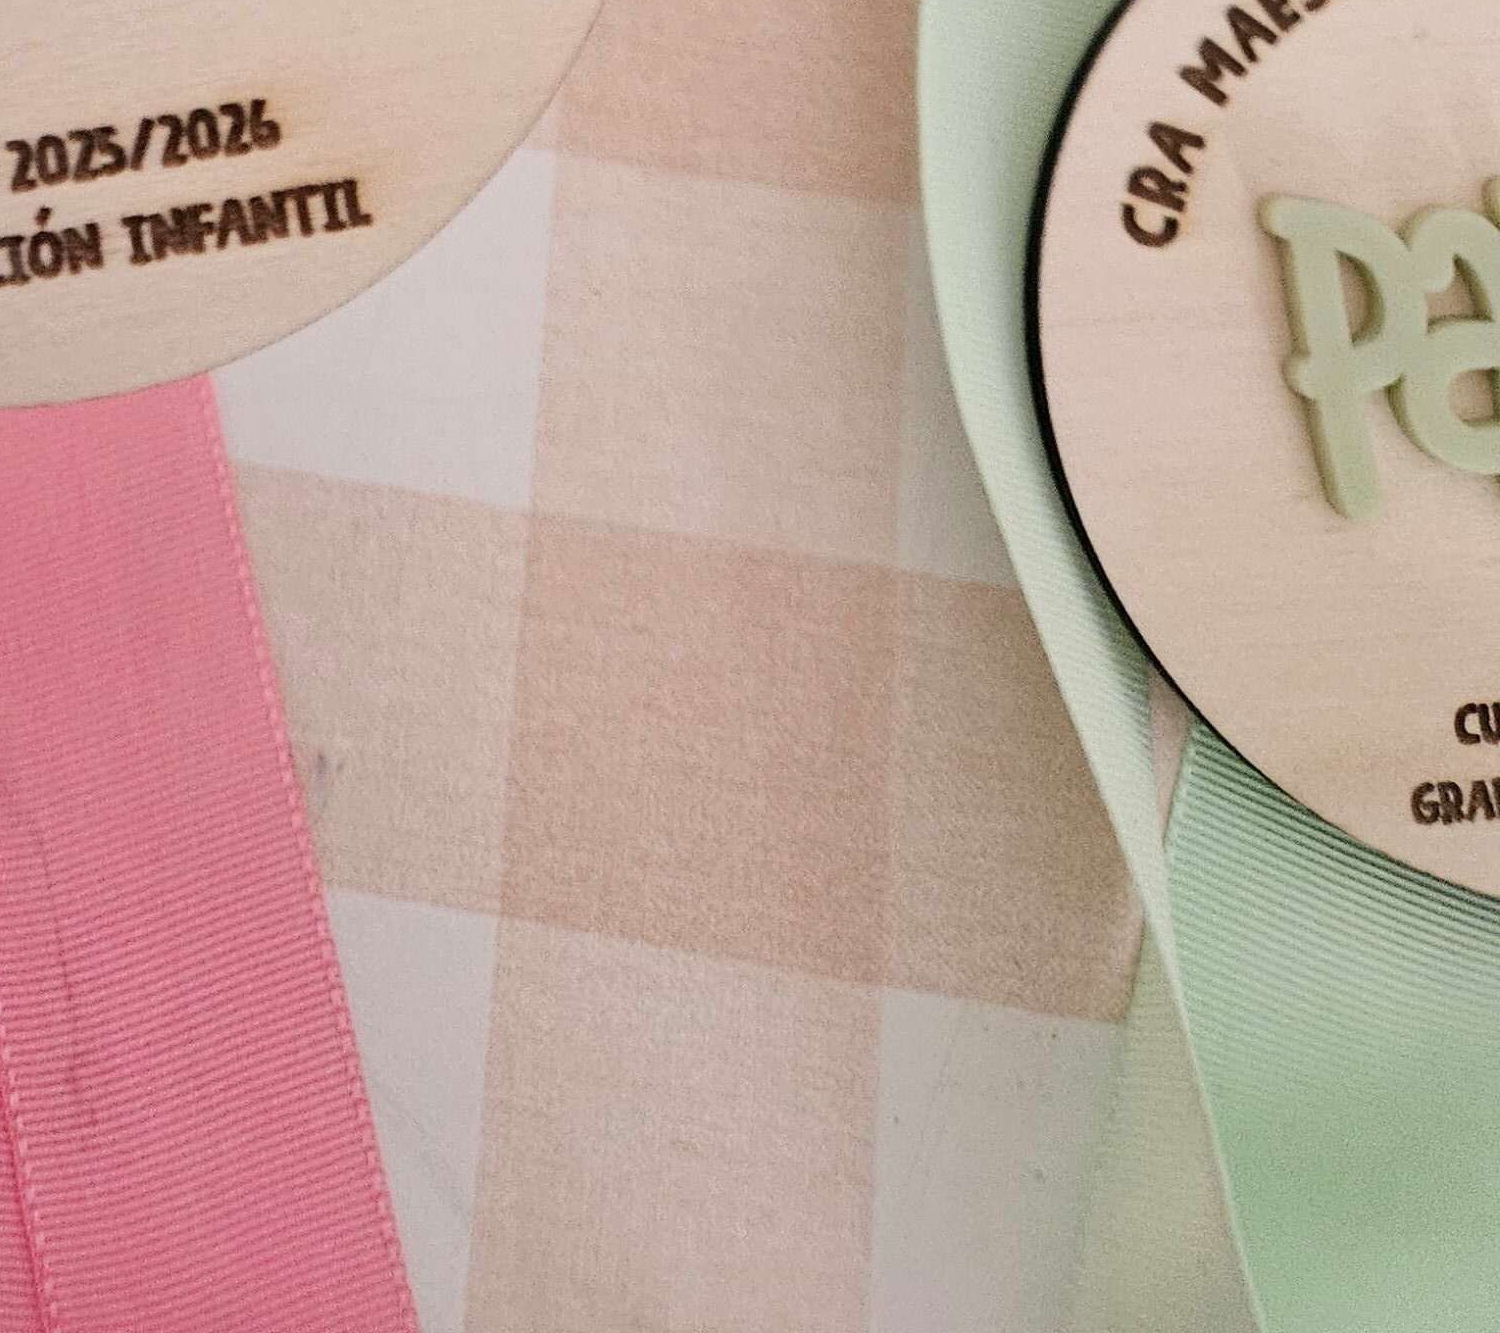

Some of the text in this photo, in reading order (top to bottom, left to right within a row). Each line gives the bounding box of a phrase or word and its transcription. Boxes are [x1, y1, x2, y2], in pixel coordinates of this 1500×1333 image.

[6, 97, 284, 194] 2025/2026
[1120, 120, 1206, 249] CRA
[122, 176, 373, 267] INFANTIL
[1255, 175, 1500, 525] Pa
